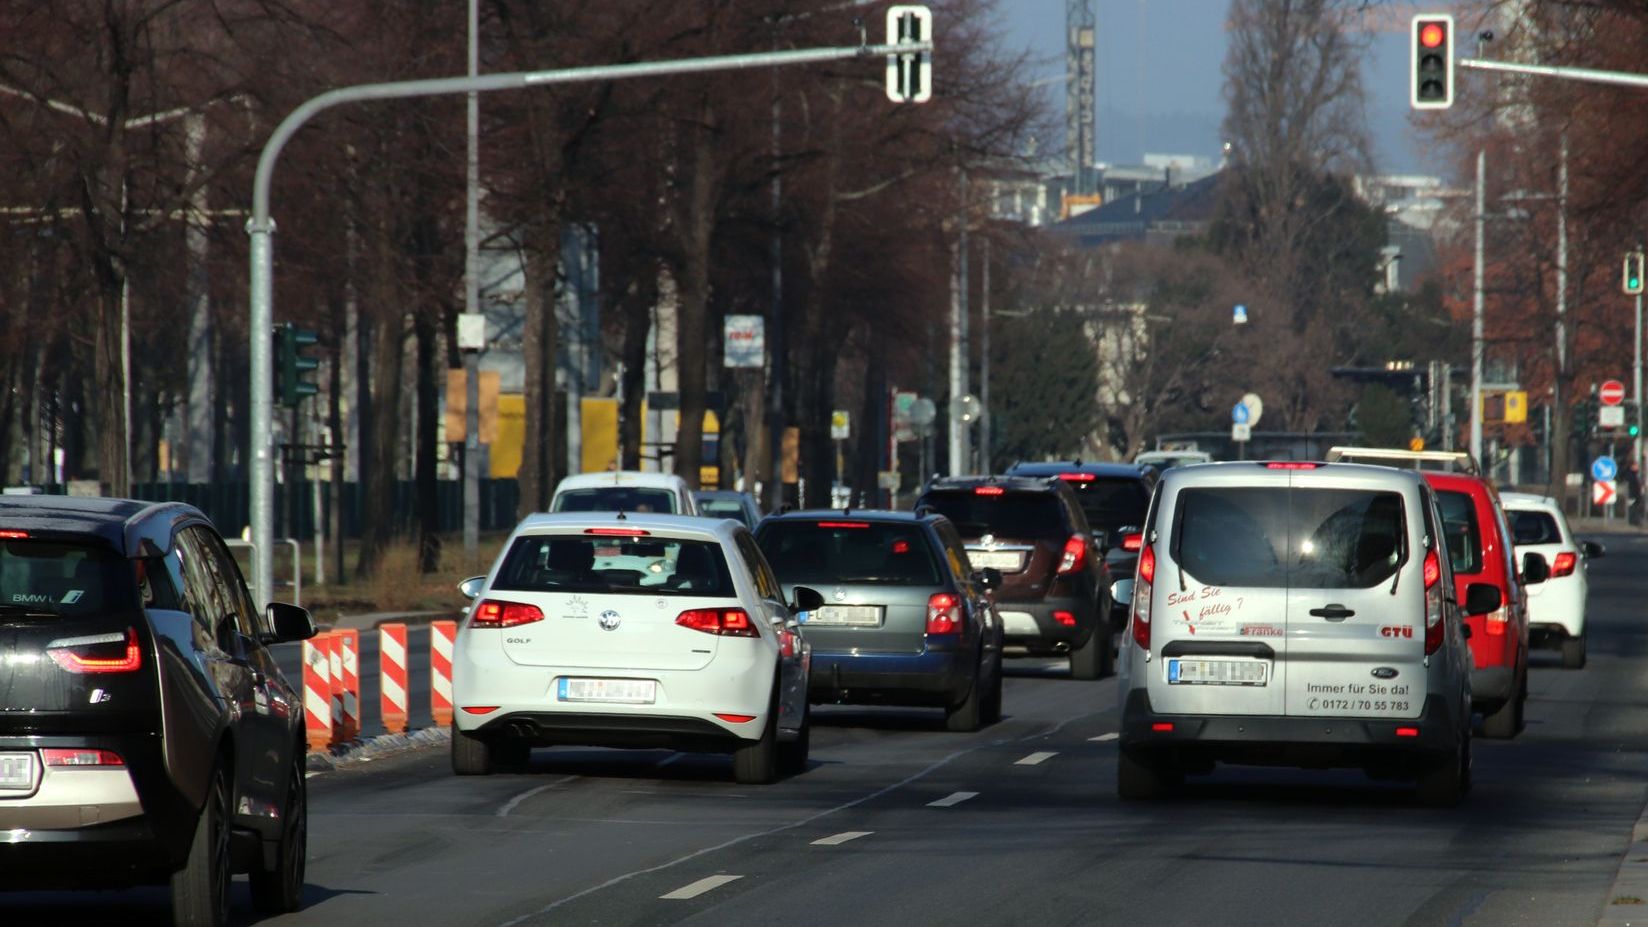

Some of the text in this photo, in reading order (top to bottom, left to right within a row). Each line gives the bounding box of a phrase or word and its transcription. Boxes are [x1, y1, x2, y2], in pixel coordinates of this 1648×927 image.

[12, 594, 46, 602] BMW
[1168, 586, 1222, 607] Sind Sie
[1200, 603, 1232, 620] fällig
[1381, 625, 1413, 638] GTÜ
[1307, 683, 1409, 695] Immer für Sie da!
[1322, 700, 1348, 709] 0172
[1358, 700, 1371, 710] 70
[1374, 701, 1387, 710] 55
[1390, 701, 1409, 711] 783
